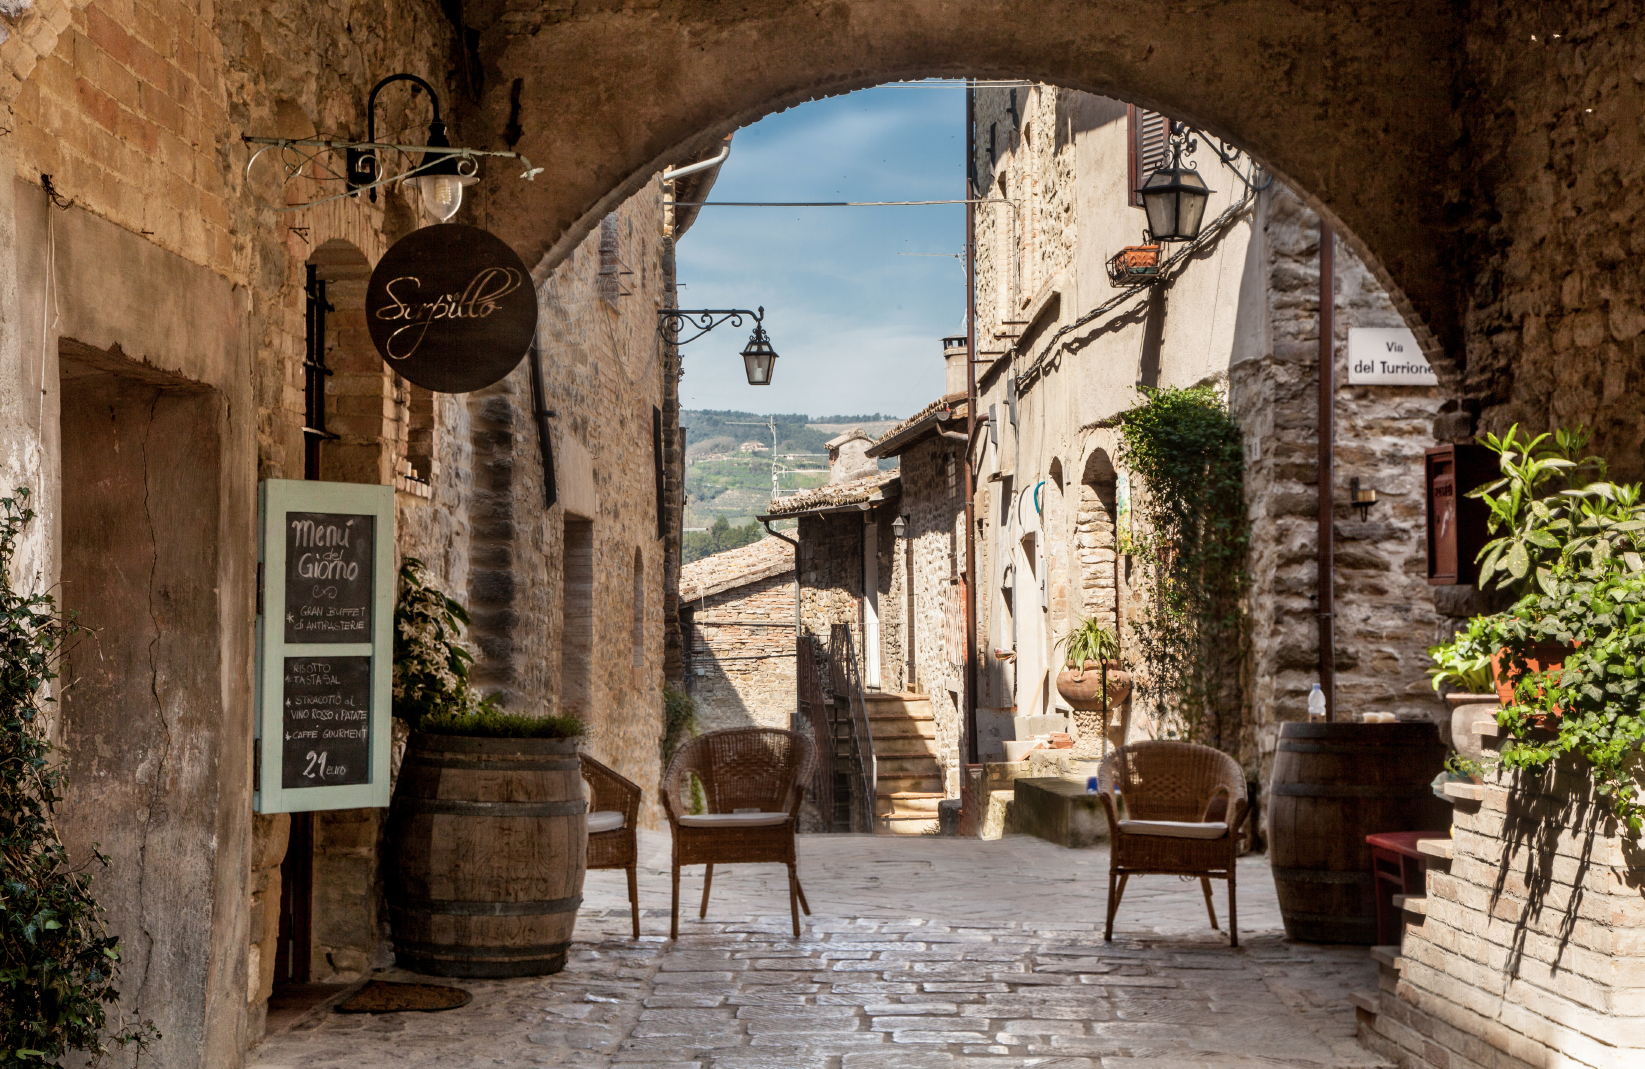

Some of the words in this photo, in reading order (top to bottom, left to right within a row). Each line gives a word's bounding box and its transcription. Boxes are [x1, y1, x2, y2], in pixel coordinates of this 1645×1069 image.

[1386, 341, 1404, 353] Via
[1354, 360, 1375, 374] del
[323, 548, 344, 561] del
[298, 553, 359, 580] Giorno
[300, 605, 323, 617] GRAN
[326, 606, 365, 617] BUFFET
[293, 662, 331, 674] RISOTTO
[290, 710, 309, 720] VINO
[312, 709, 334, 721] ROSSO
[340, 709, 368, 721] PATATE
[302, 750, 328, 780] 21
